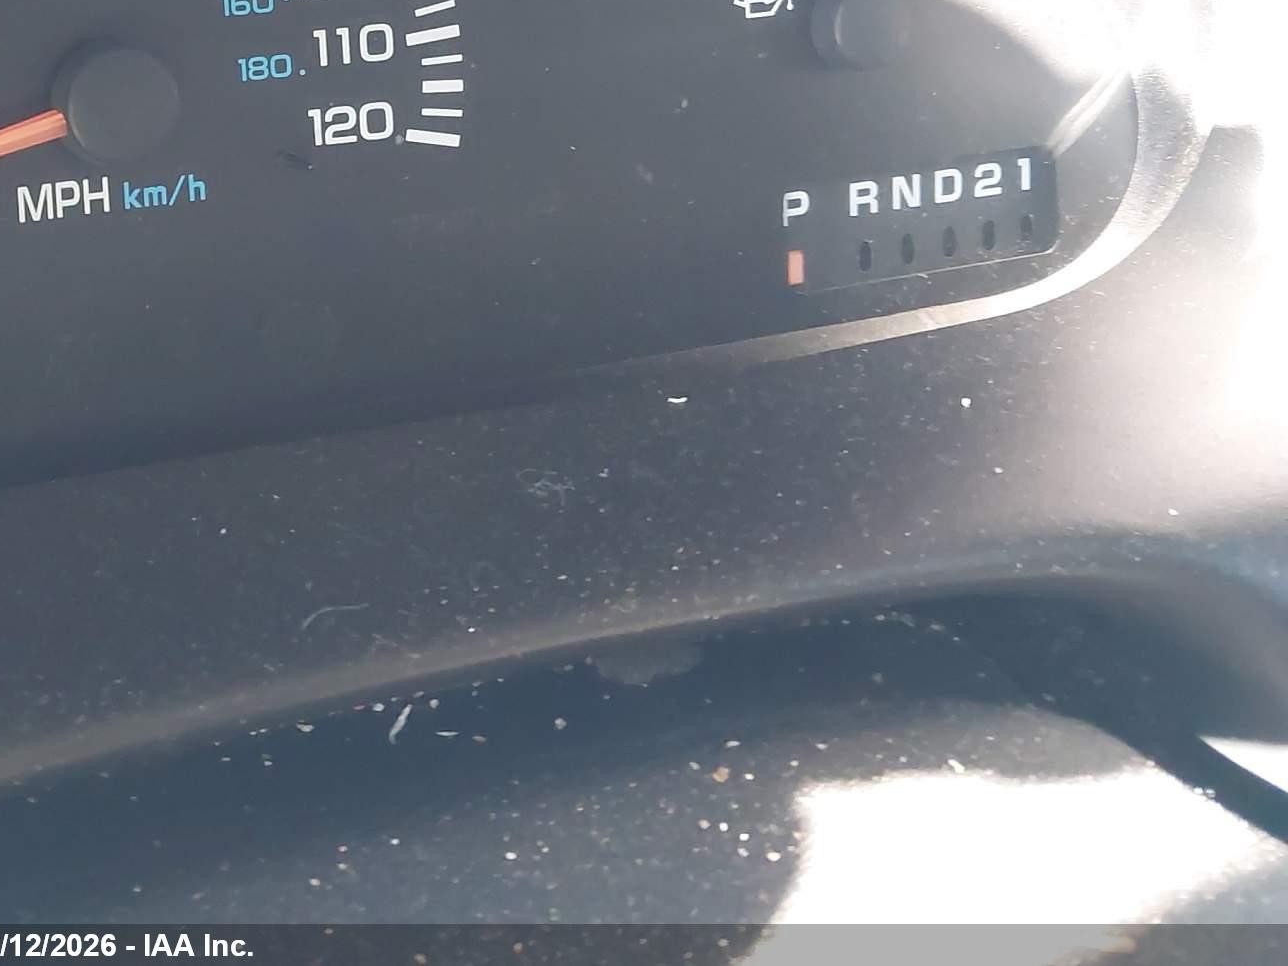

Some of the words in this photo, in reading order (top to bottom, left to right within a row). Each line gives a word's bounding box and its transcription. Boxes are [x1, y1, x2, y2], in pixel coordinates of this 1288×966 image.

[313, 23, 394, 67] 110
[238, 54, 293, 82] 180
[308, 101, 394, 146] 120
[16, 176, 110, 223] MPH
[122, 174, 207, 210] km/h
[782, 190, 810, 227] P
